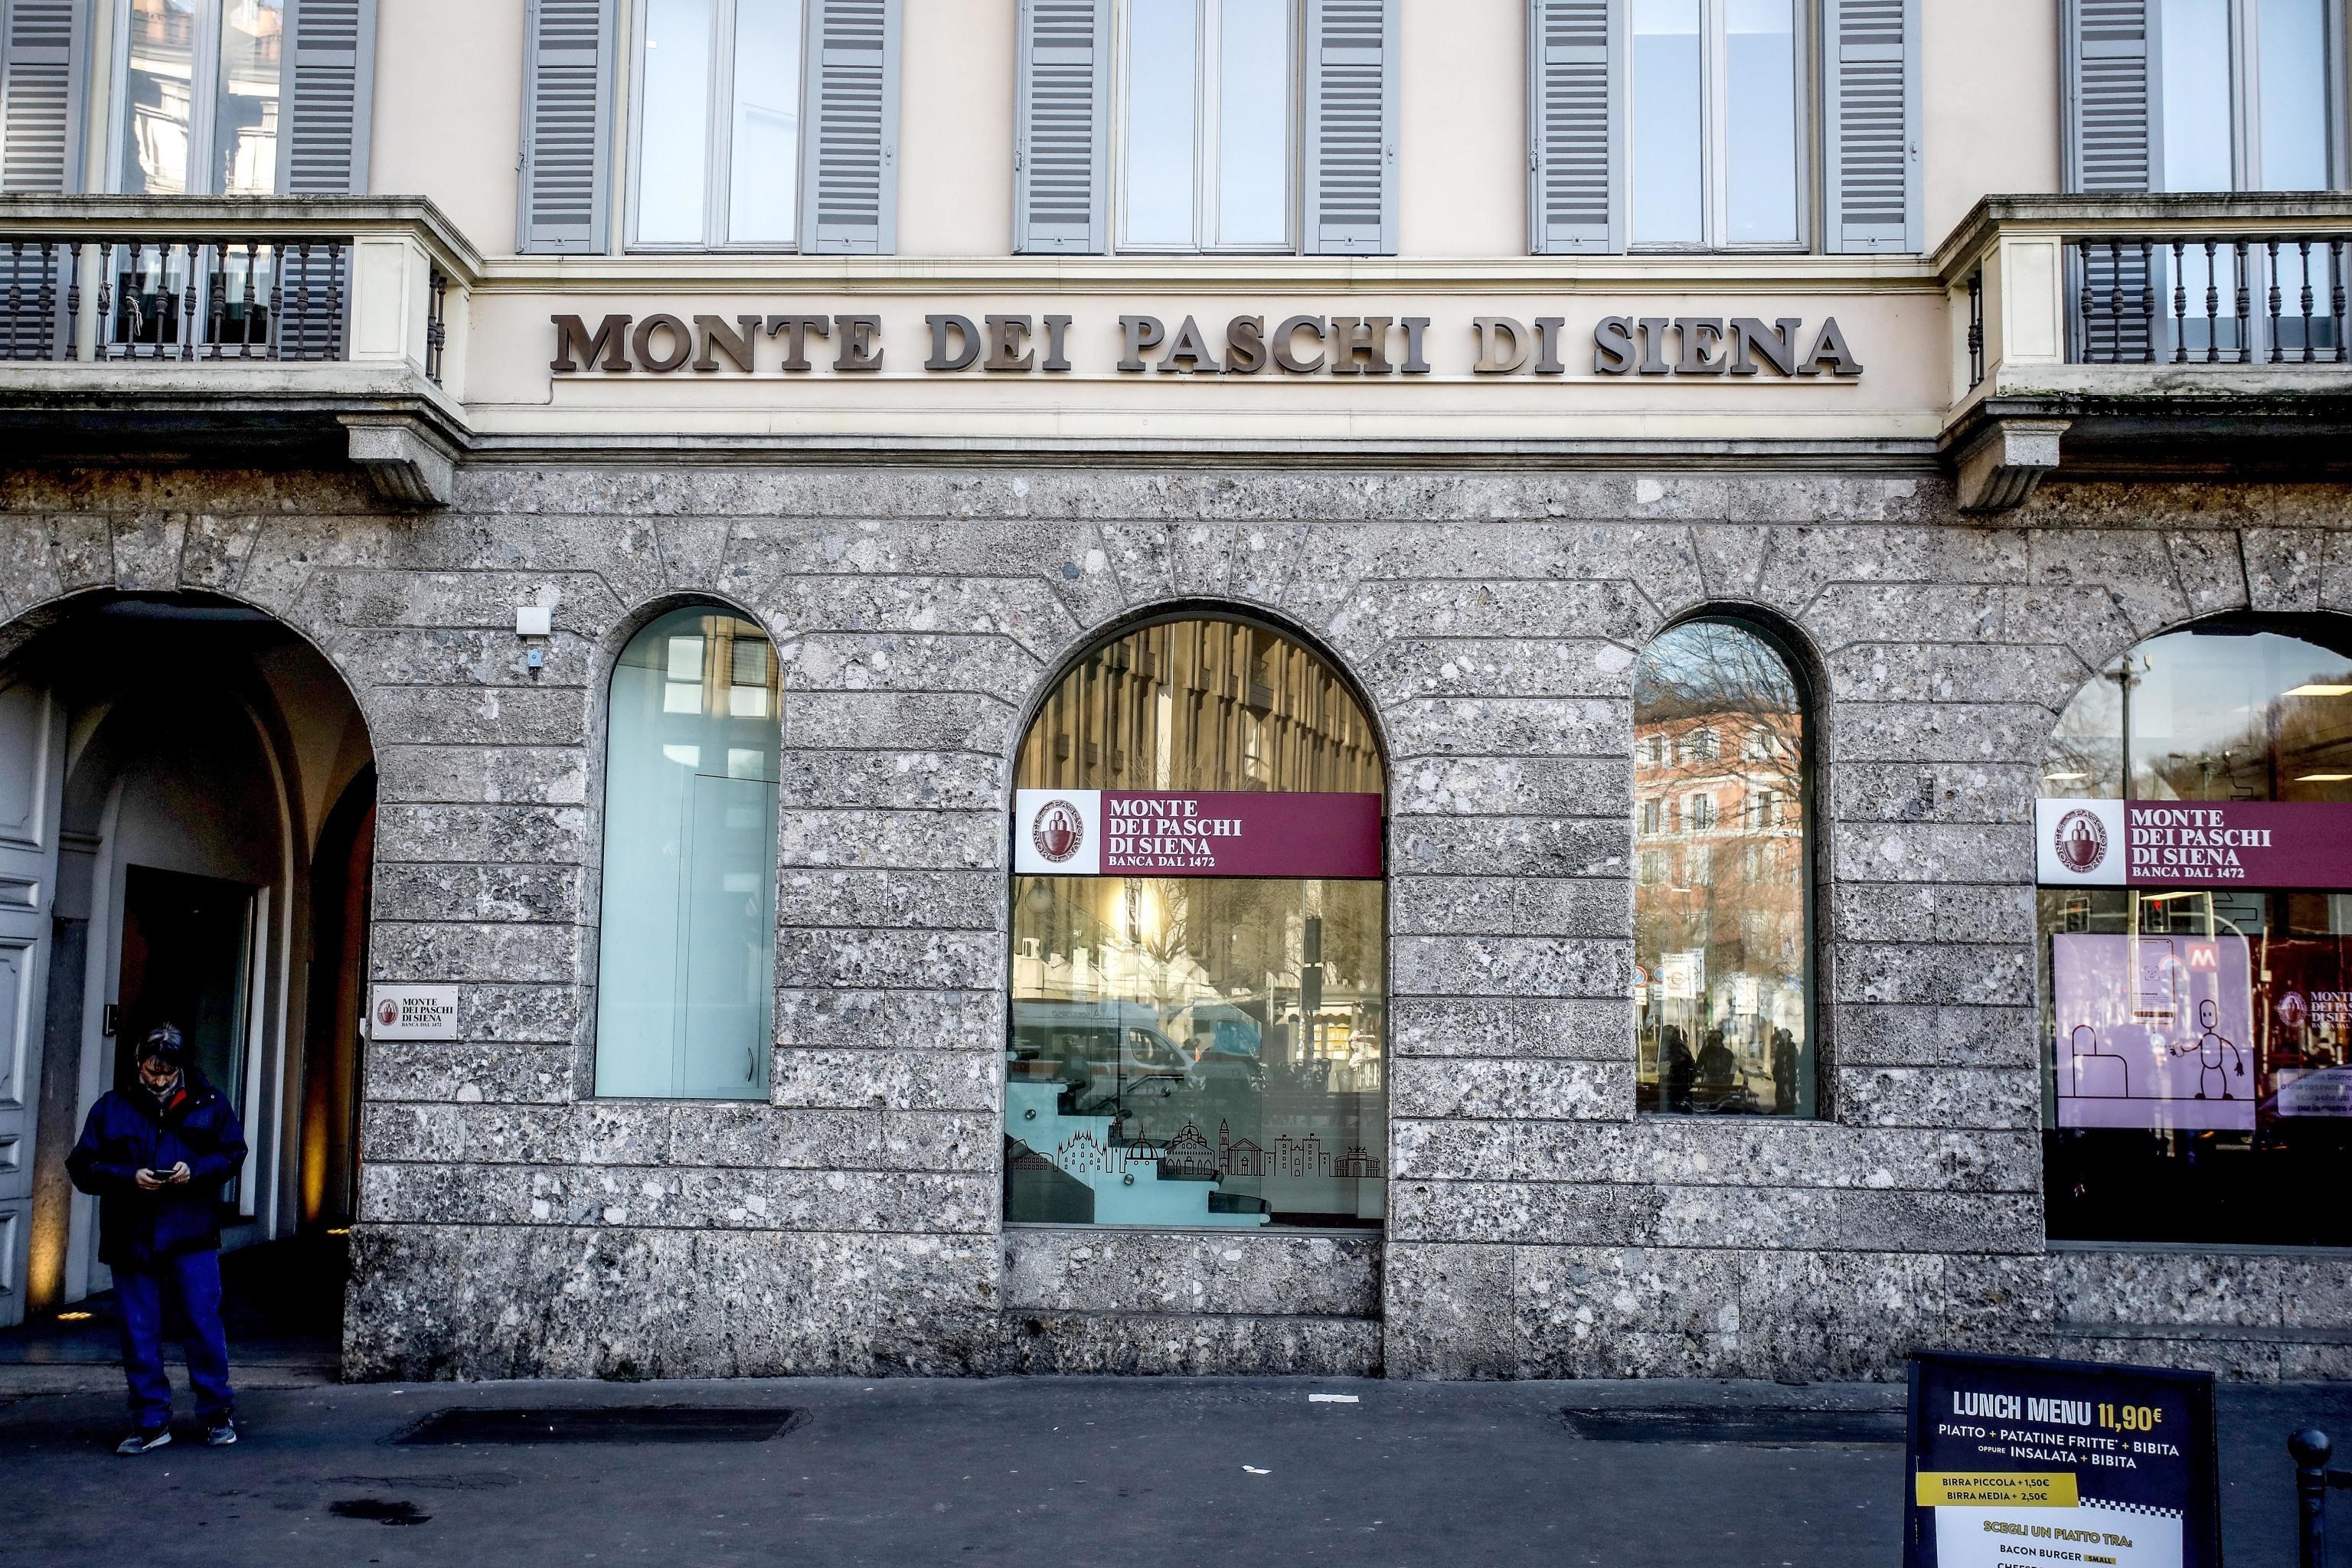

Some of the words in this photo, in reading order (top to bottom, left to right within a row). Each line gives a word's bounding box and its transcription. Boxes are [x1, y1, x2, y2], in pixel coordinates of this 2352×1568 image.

[550, 314, 884, 372] MONTE
[924, 314, 1073, 372] DEI
[1117, 315, 1431, 374] PASCHI
[1473, 316, 1565, 374] DI
[1594, 315, 1864, 377] SIENA
[1109, 799, 1197, 817] MONTE
[1109, 818, 1150, 835] DEI
[1155, 818, 1242, 836] PASCHI
[2130, 809, 2223, 827] MONTE
[1109, 838, 1135, 854] DI
[1138, 838, 1211, 855] SIENA
[2132, 828, 2175, 845] DEI
[2180, 828, 2272, 847] PASCHI
[1109, 856, 1154, 866] BANCA
[1158, 857, 1185, 867] DAL
[1189, 857, 1216, 867] 1472
[2132, 848, 2158, 864] DI
[2163, 848, 2240, 866] SIENA
[2132, 867, 2180, 877] BANCA
[2185, 867, 2213, 877] DAL
[2217, 867, 2245, 878] 1472
[2311, 1001, 2332, 1011] DEI
[2311, 1012, 2324, 1022] DI
[1954, 1391, 2020, 1419] LUNCH
[2028, 1397, 2091, 1426] MENU
[2098, 1403, 2162, 1432] 11,90€
[1939, 1424, 1985, 1438] PIATTO
[2001, 1429, 2064, 1446] PATATINE
[2134, 1442, 2179, 1456] BIBITA
[2011, 1446, 2077, 1463] INSALATA
[2092, 1454, 2137, 1468] BIBITA
[2024, 1479, 2050, 1488] 1,50€
[2021, 1492, 2047, 1501] 2,50€
[1983, 1521, 2028, 1536] SCEGLI
[2031, 1525, 2051, 1539] UN
[2054, 1528, 2100, 1544] PIATTO
[2103, 1533, 2133, 1547] TRA:
[2000, 1544, 2037, 1557] BACON
[2040, 1549, 2082, 1561] BURGER
[2088, 1556, 2112, 1564] SMALL
